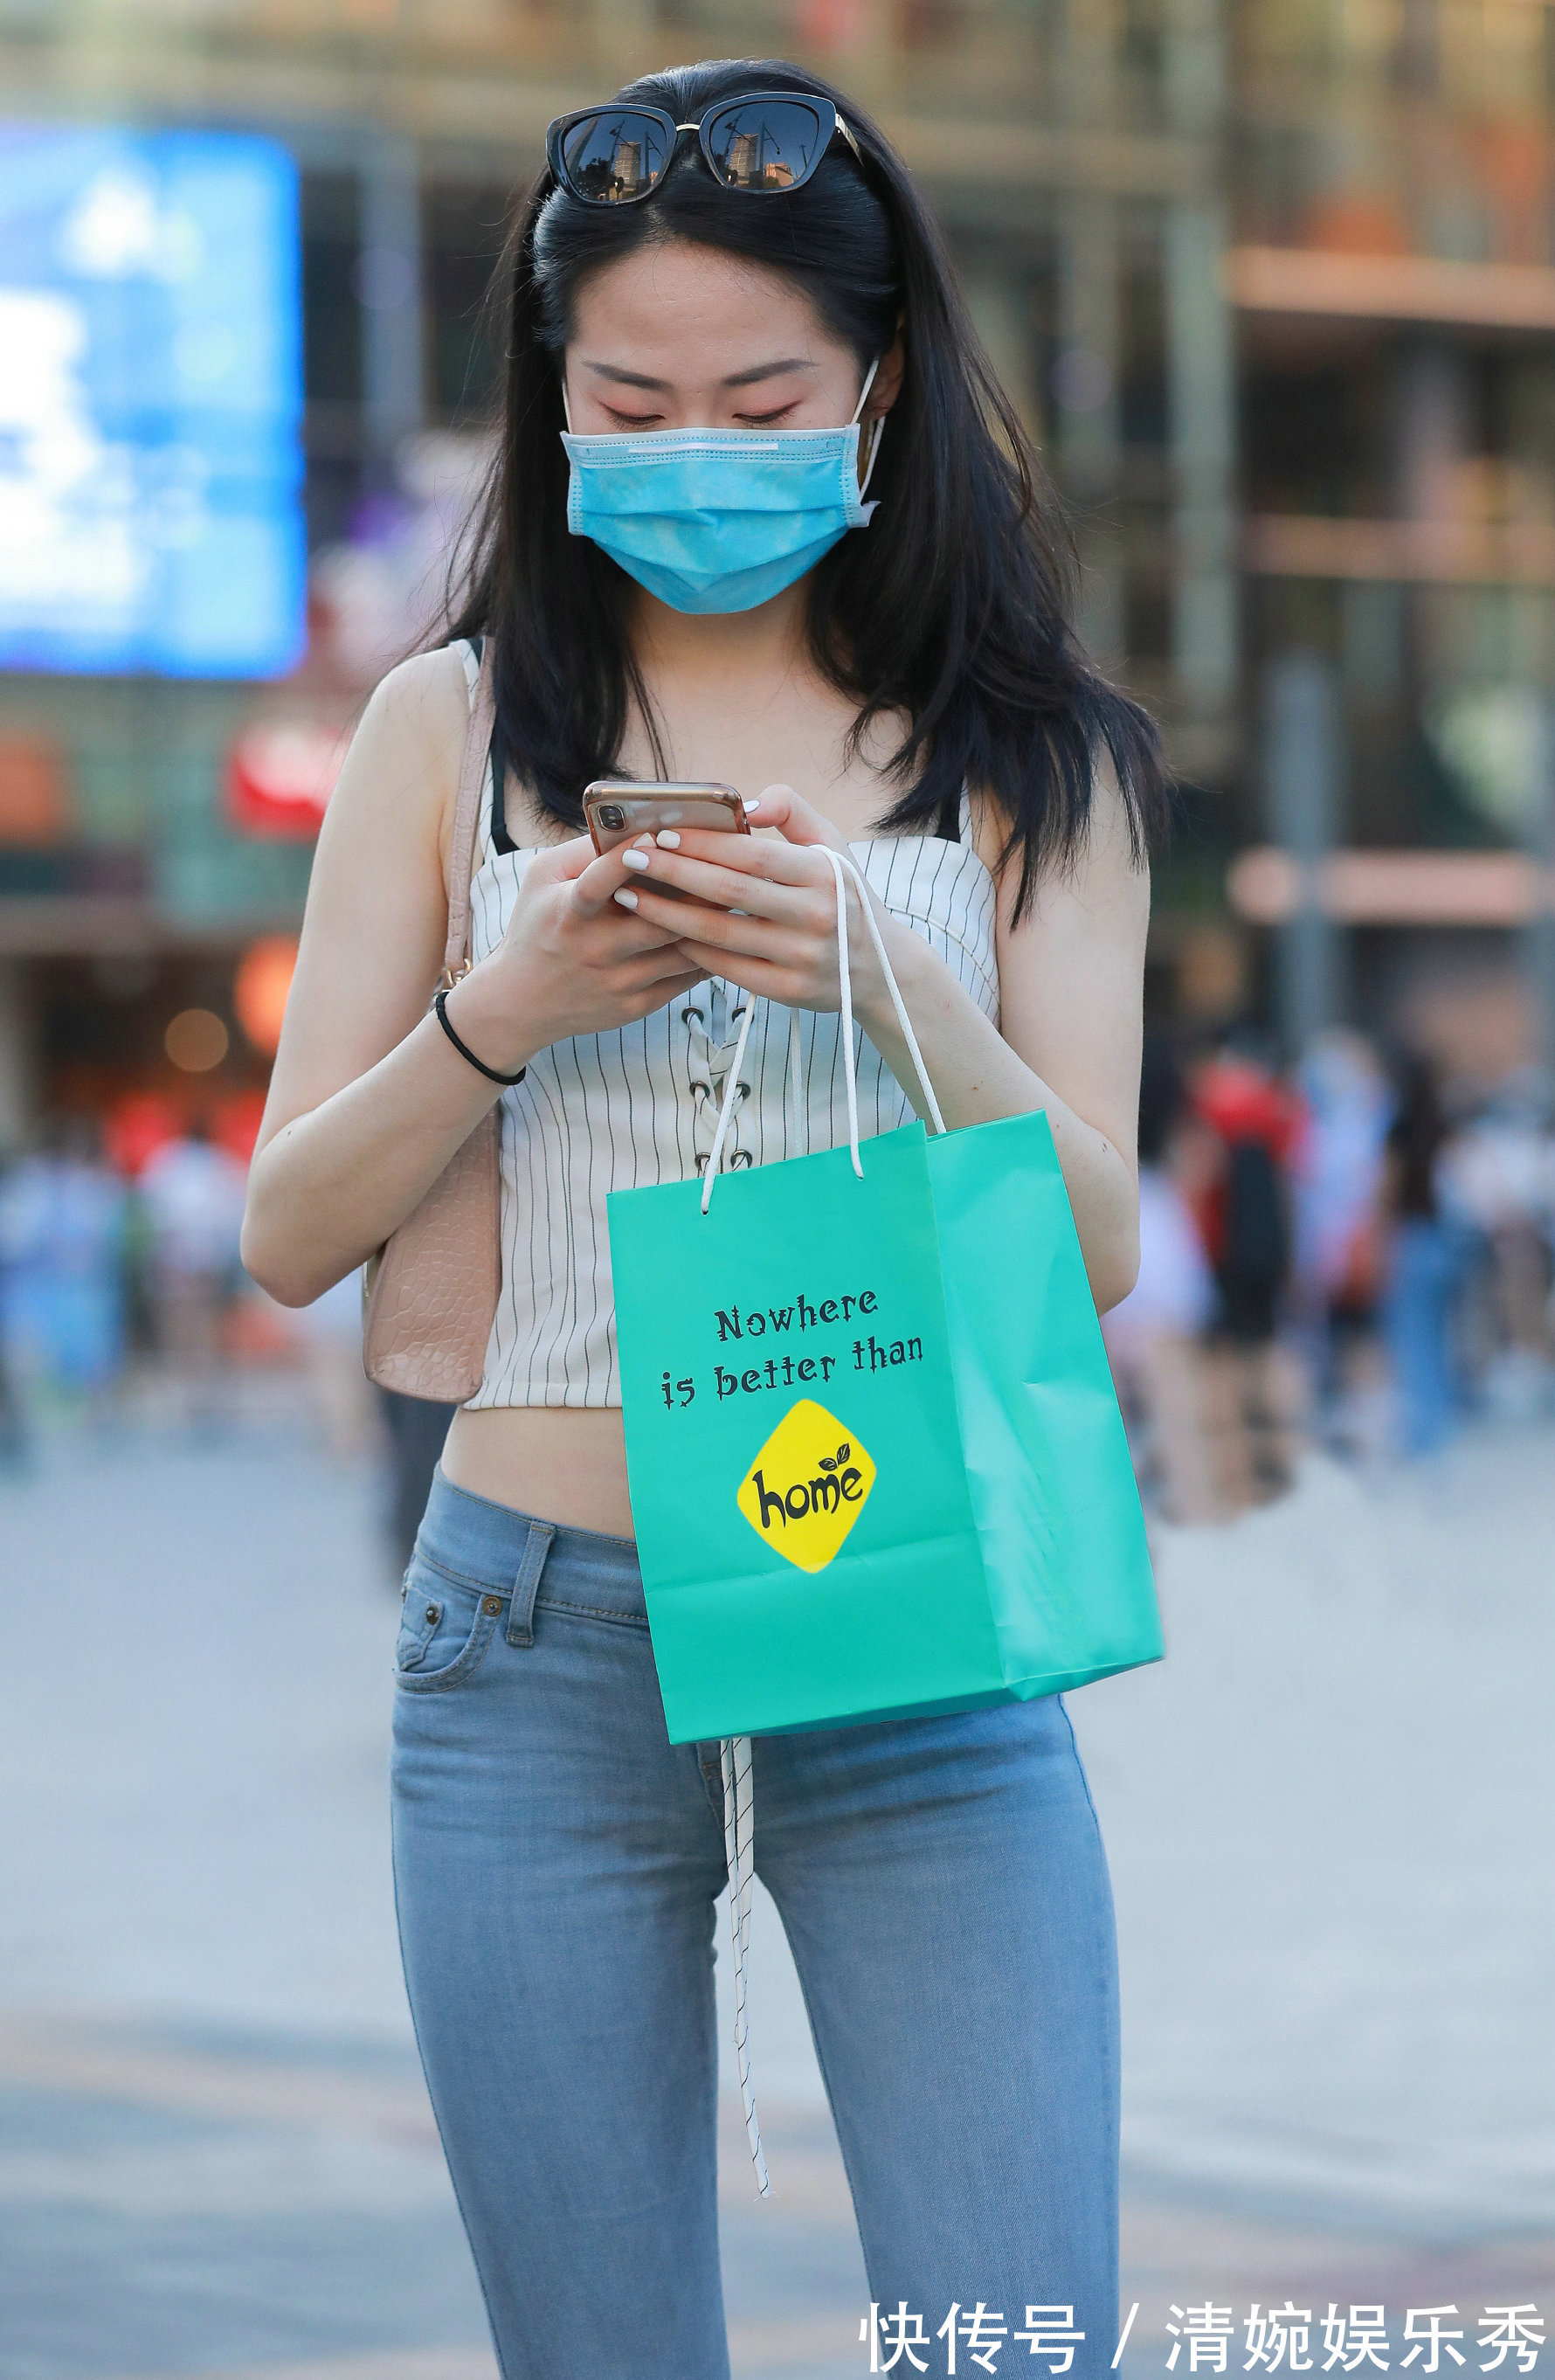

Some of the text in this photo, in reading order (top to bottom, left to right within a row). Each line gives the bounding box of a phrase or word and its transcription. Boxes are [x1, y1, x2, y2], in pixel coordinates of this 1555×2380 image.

[714, 1290, 879, 1342] Nowhere
[660, 1335, 924, 1410] is better than
[751, 1467, 863, 1529] home
